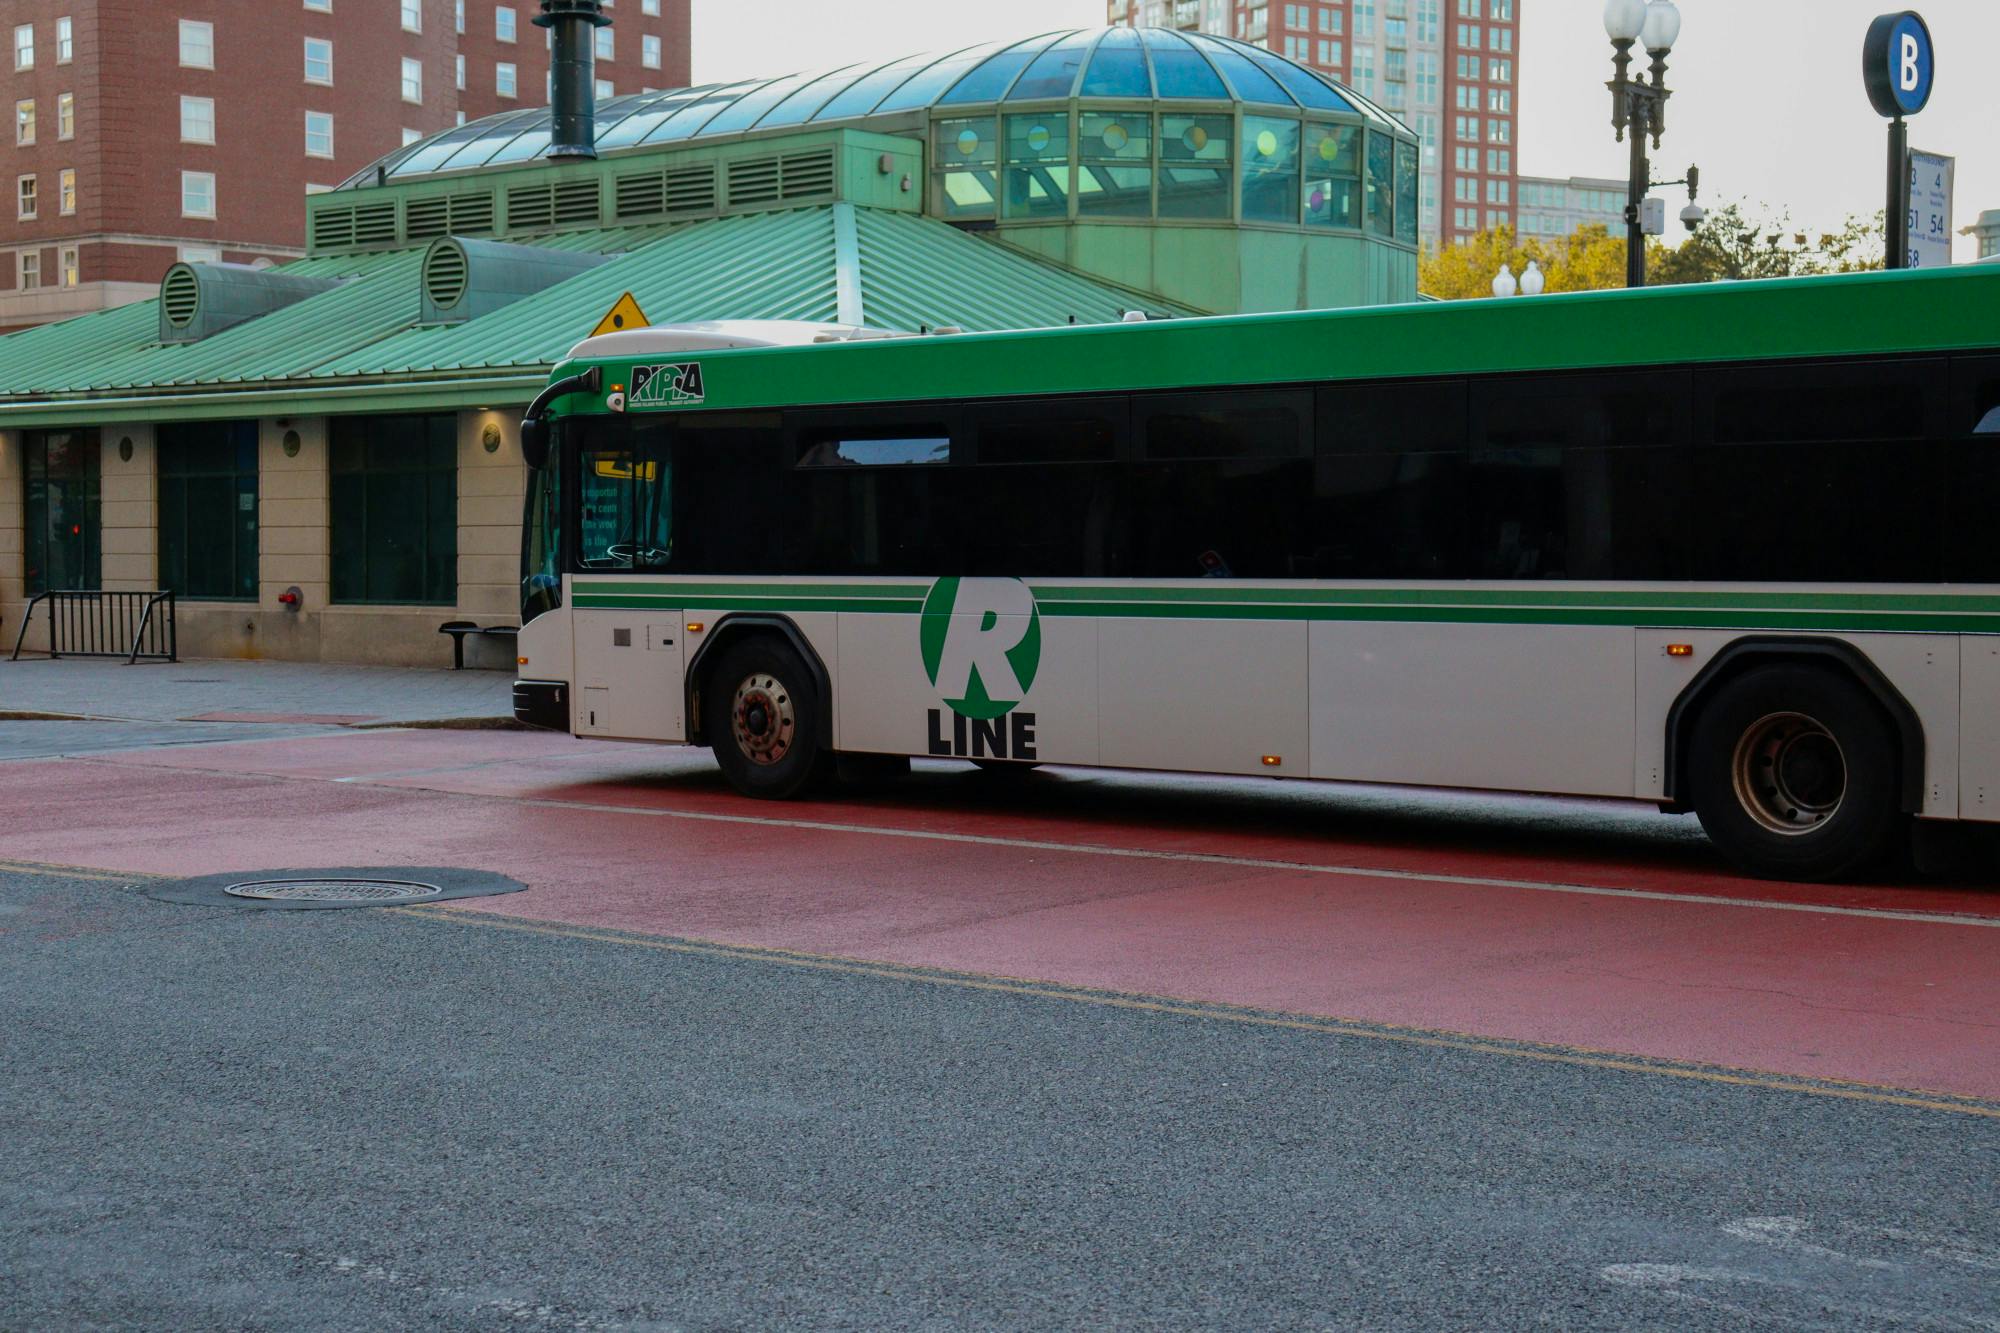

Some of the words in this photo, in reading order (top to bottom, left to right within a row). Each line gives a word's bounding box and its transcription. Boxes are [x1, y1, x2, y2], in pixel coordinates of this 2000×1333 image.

[1900, 33, 1918, 92] B
[1912, 153, 1945, 167] OUTHBOUND
[1935, 173, 1941, 188] 4
[1930, 214, 1944, 234] 54
[629, 362, 705, 402] RIPTA
[934, 576, 1034, 703] R
[928, 709, 1037, 760] LINE
